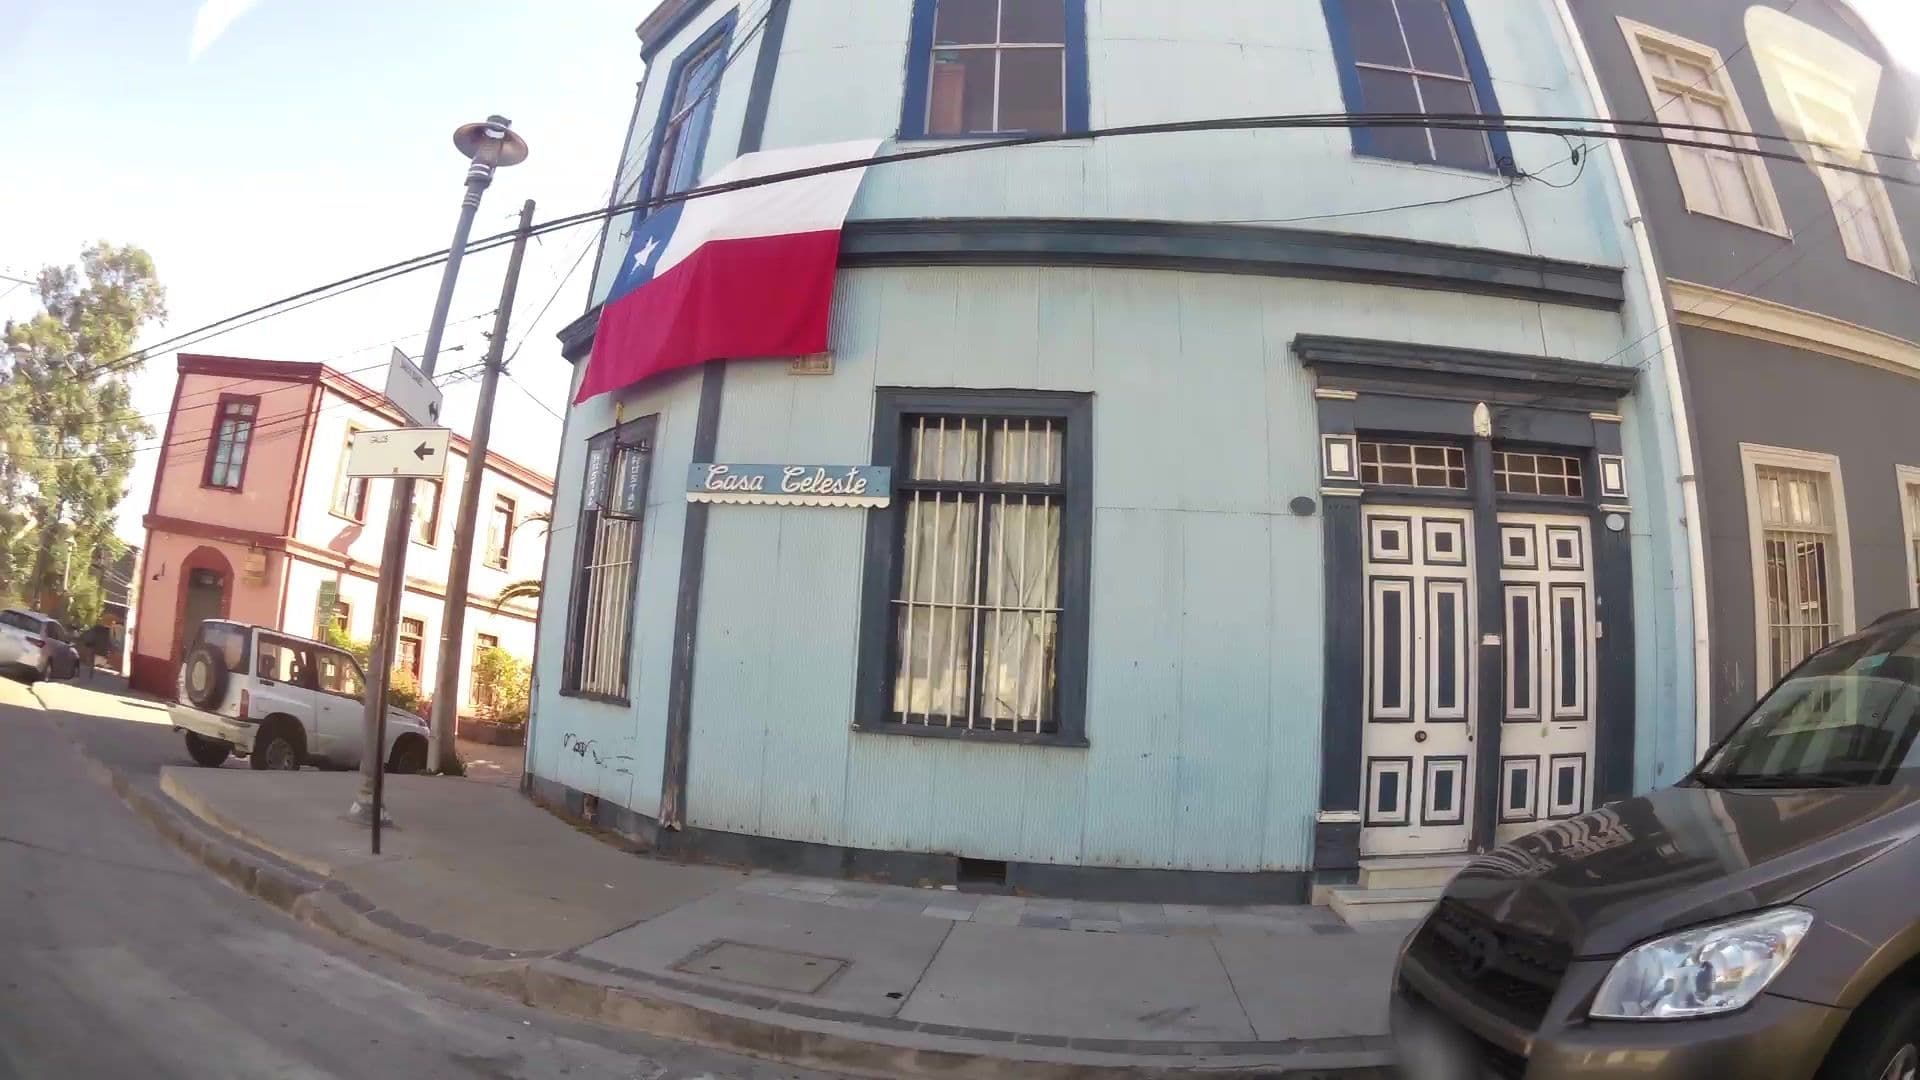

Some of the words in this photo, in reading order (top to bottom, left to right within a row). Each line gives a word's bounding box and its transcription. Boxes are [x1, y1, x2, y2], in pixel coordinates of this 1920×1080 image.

[626, 455, 640, 510] HOSTAL
[704, 464, 764, 492] Casa
[781, 465, 867, 494] Celeste
